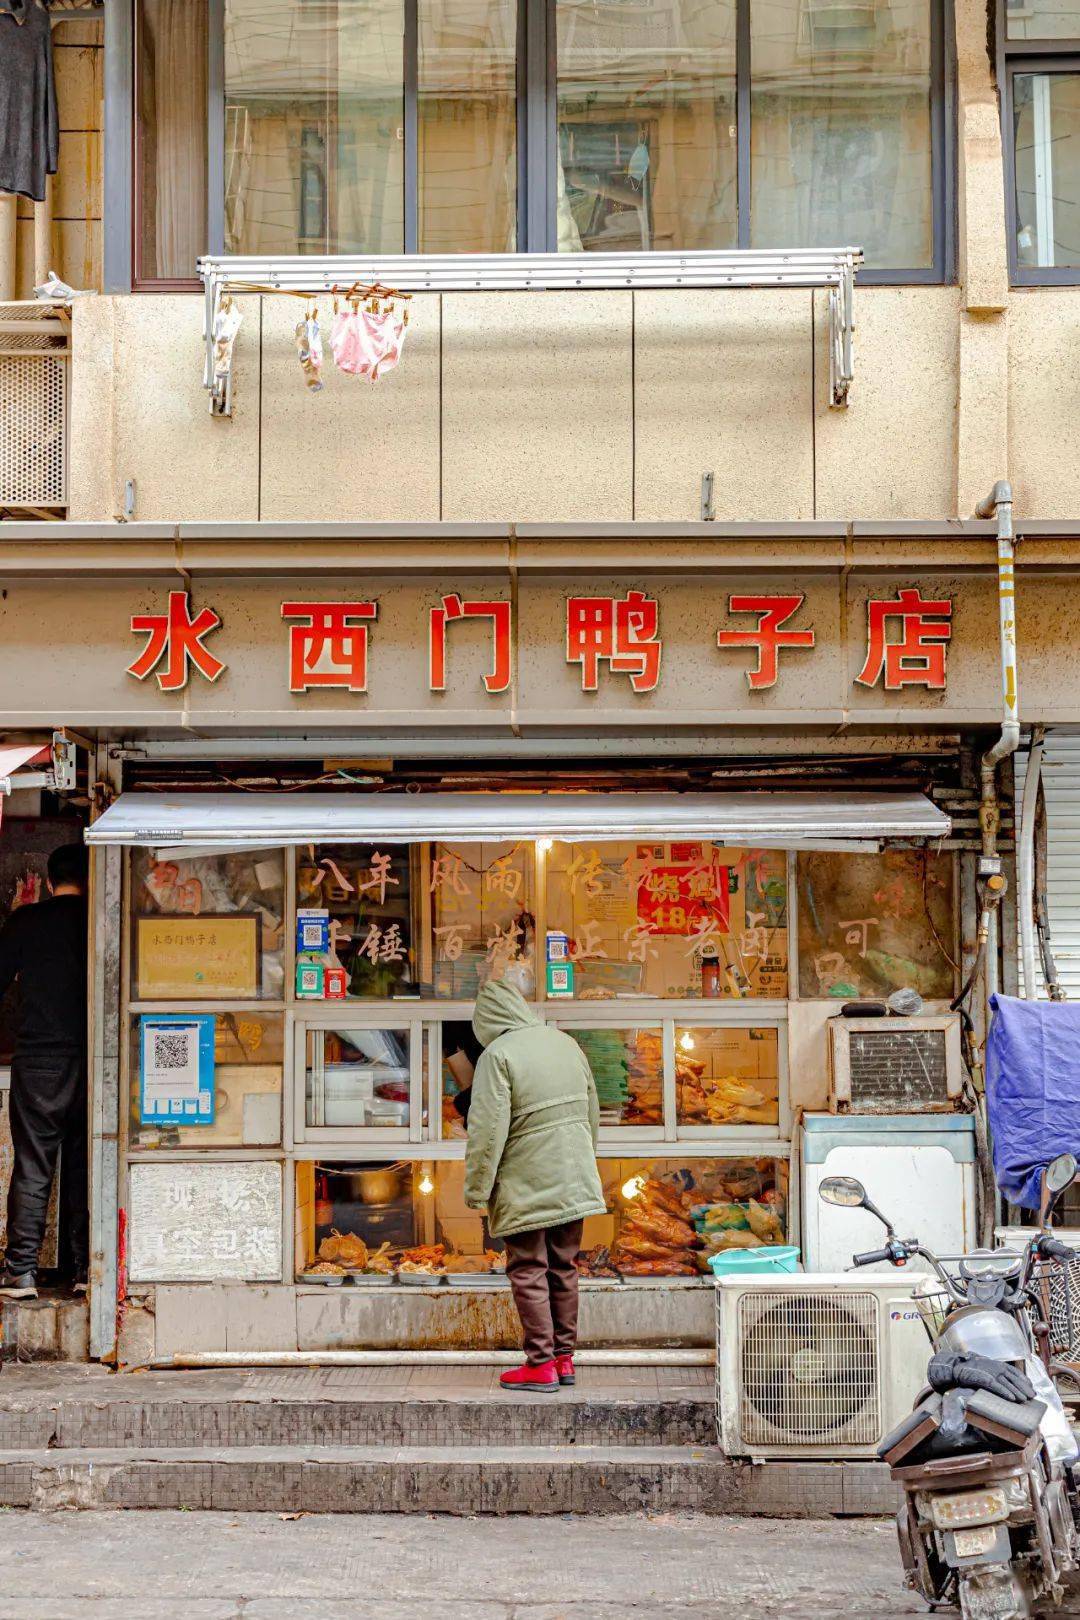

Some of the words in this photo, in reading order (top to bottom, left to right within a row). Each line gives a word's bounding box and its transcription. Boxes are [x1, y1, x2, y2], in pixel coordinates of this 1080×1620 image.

[127, 589, 953, 693] 水西门鸭子店
[903, 1312, 921, 1321] GR
